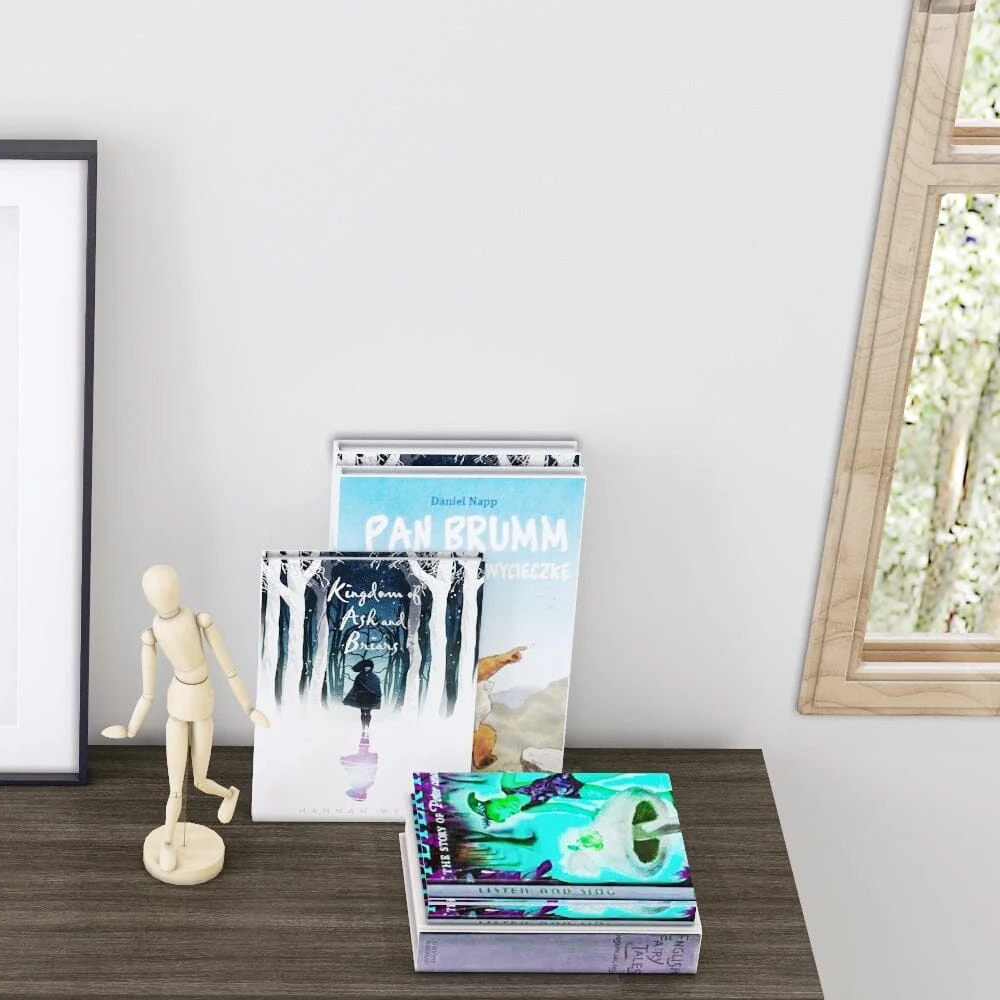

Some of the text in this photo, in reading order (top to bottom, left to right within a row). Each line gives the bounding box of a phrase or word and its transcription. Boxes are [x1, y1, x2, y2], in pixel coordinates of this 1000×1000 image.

[430, 496, 498, 508] Daniel Napp
[364, 514, 569, 553] PAN BRUMM
[327, 577, 421, 606] Kingdom of
[340, 606, 407, 630] Ash and
[344, 630, 399, 656] Briars
[299, 807, 368, 815] HANNAH
[434, 813, 445, 824] OF
[436, 825, 450, 852] STORY
[440, 854, 453, 876] THE
